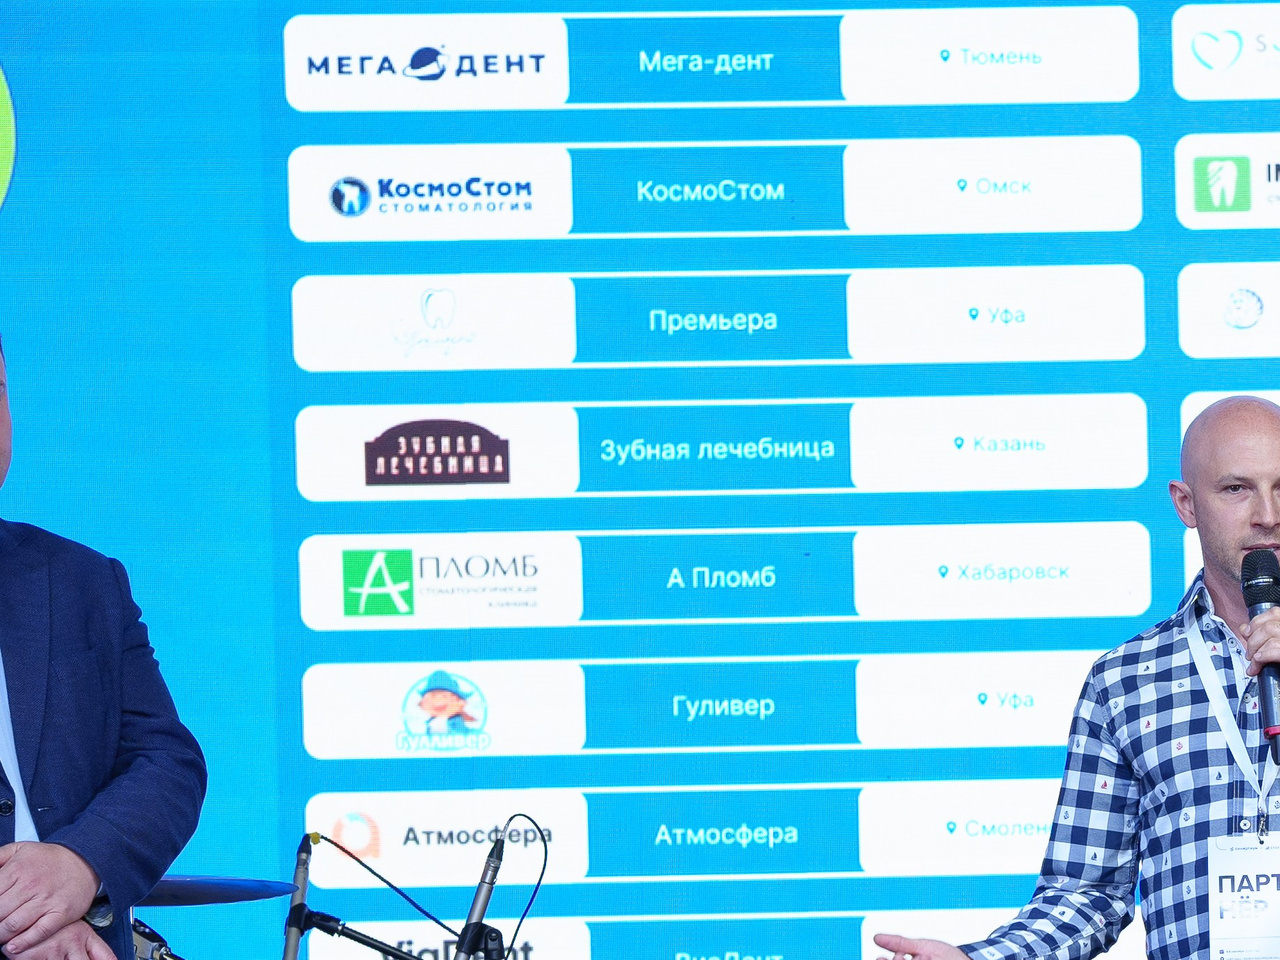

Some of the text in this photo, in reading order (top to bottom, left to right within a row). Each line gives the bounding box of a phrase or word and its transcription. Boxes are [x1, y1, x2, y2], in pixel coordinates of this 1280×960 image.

[308, 54, 545, 77] МЕГА ДЕНТ
[640, 51, 774, 74] Мега-дент
[961, 48, 1042, 65] Тюмень
[378, 177, 532, 198] КосмоСтом
[638, 180, 784, 201] КосмоСтом
[976, 178, 1031, 194] Омск
[379, 201, 533, 214] СТОМАТОЛОГИЯ
[650, 310, 777, 334] Премьера
[989, 308, 1025, 325] Уфа
[397, 435, 481, 455] ЗУБНАЯ
[601, 437, 834, 465] Зубная лечебница
[974, 438, 1045, 451] Казань
[375, 455, 504, 475] ЛЕЧЕБНИЦА
[419, 555, 538, 578] ПЛОМБ
[958, 564, 1069, 583] Хабаровск
[667, 566, 775, 588] А Пломб
[673, 696, 775, 721] Гуливер
[998, 693, 1034, 710] Уфа
[655, 824, 798, 848] Атмосфера
[965, 820, 1053, 837] Смолен
